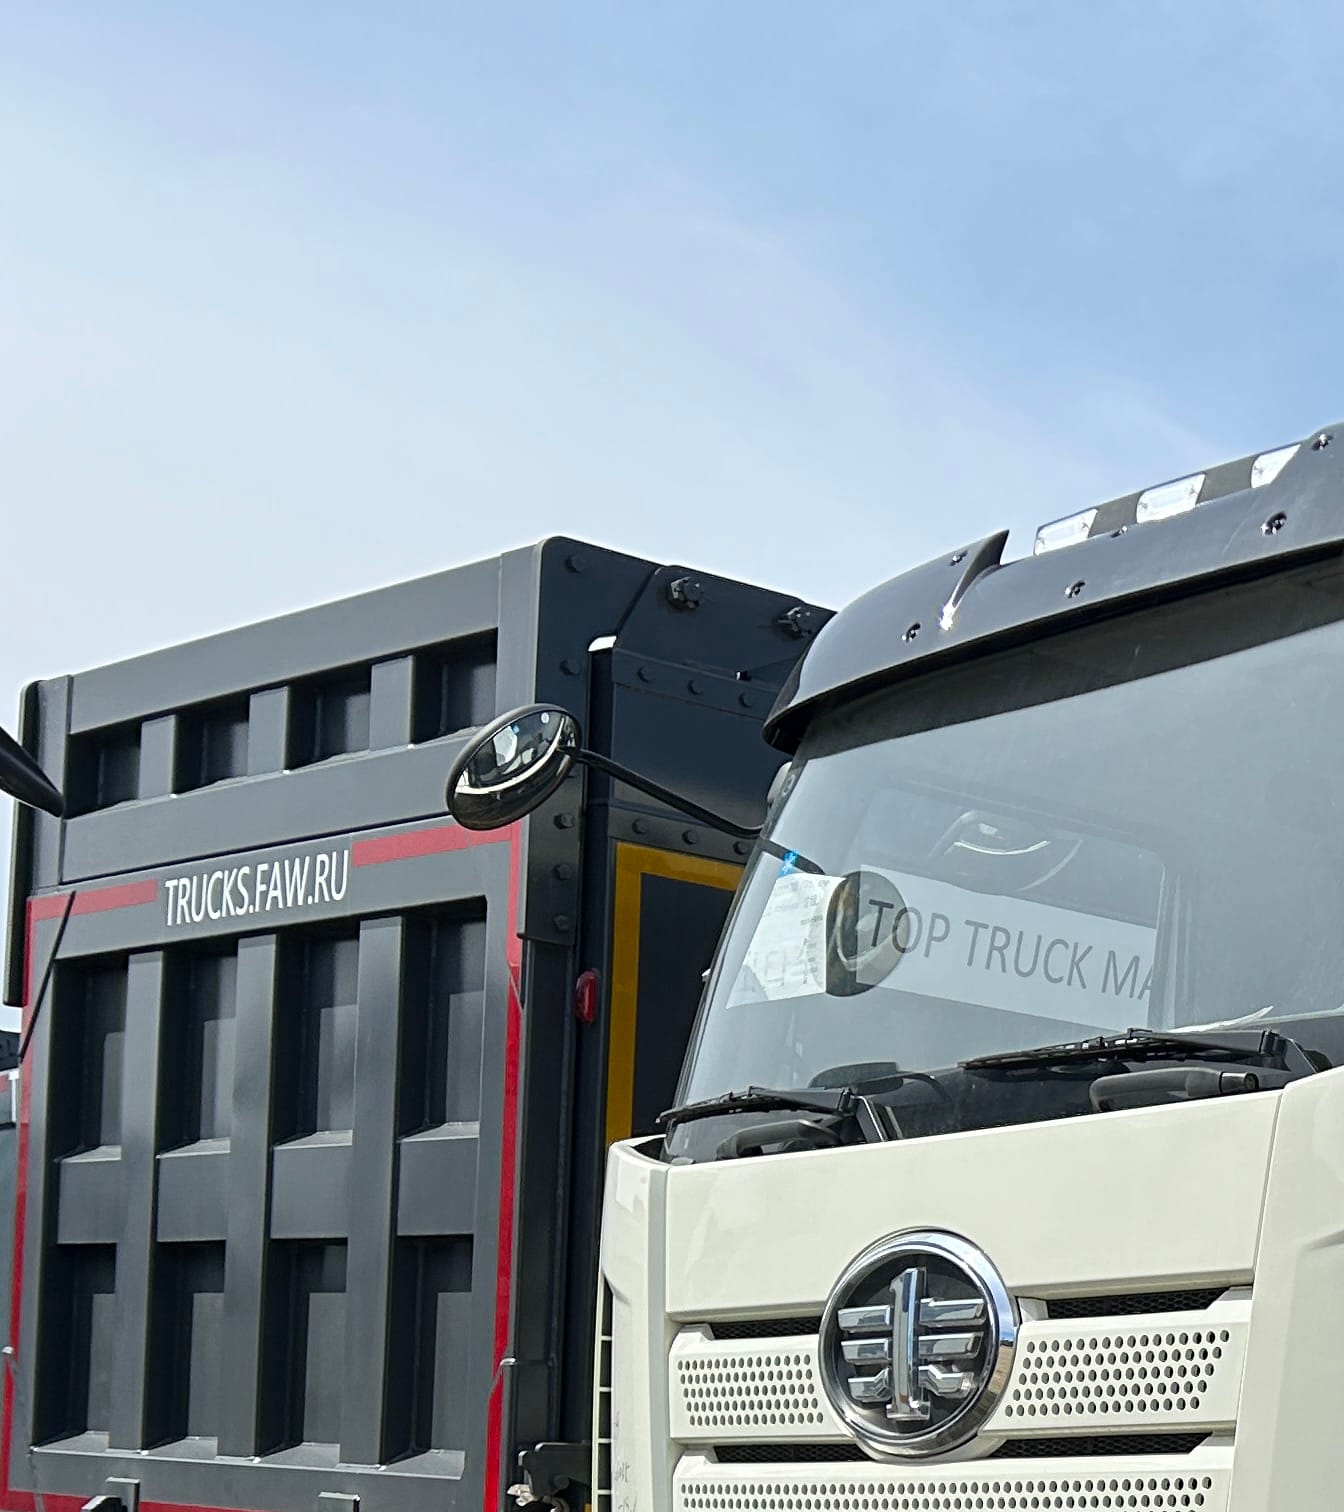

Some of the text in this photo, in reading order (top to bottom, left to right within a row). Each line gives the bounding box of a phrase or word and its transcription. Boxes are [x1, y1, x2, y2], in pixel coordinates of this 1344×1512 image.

[164, 849, 349, 927] TRUCKS.FAW.RU
[868, 899, 950, 958] TOP
[964, 919, 1093, 990] TRUCK
